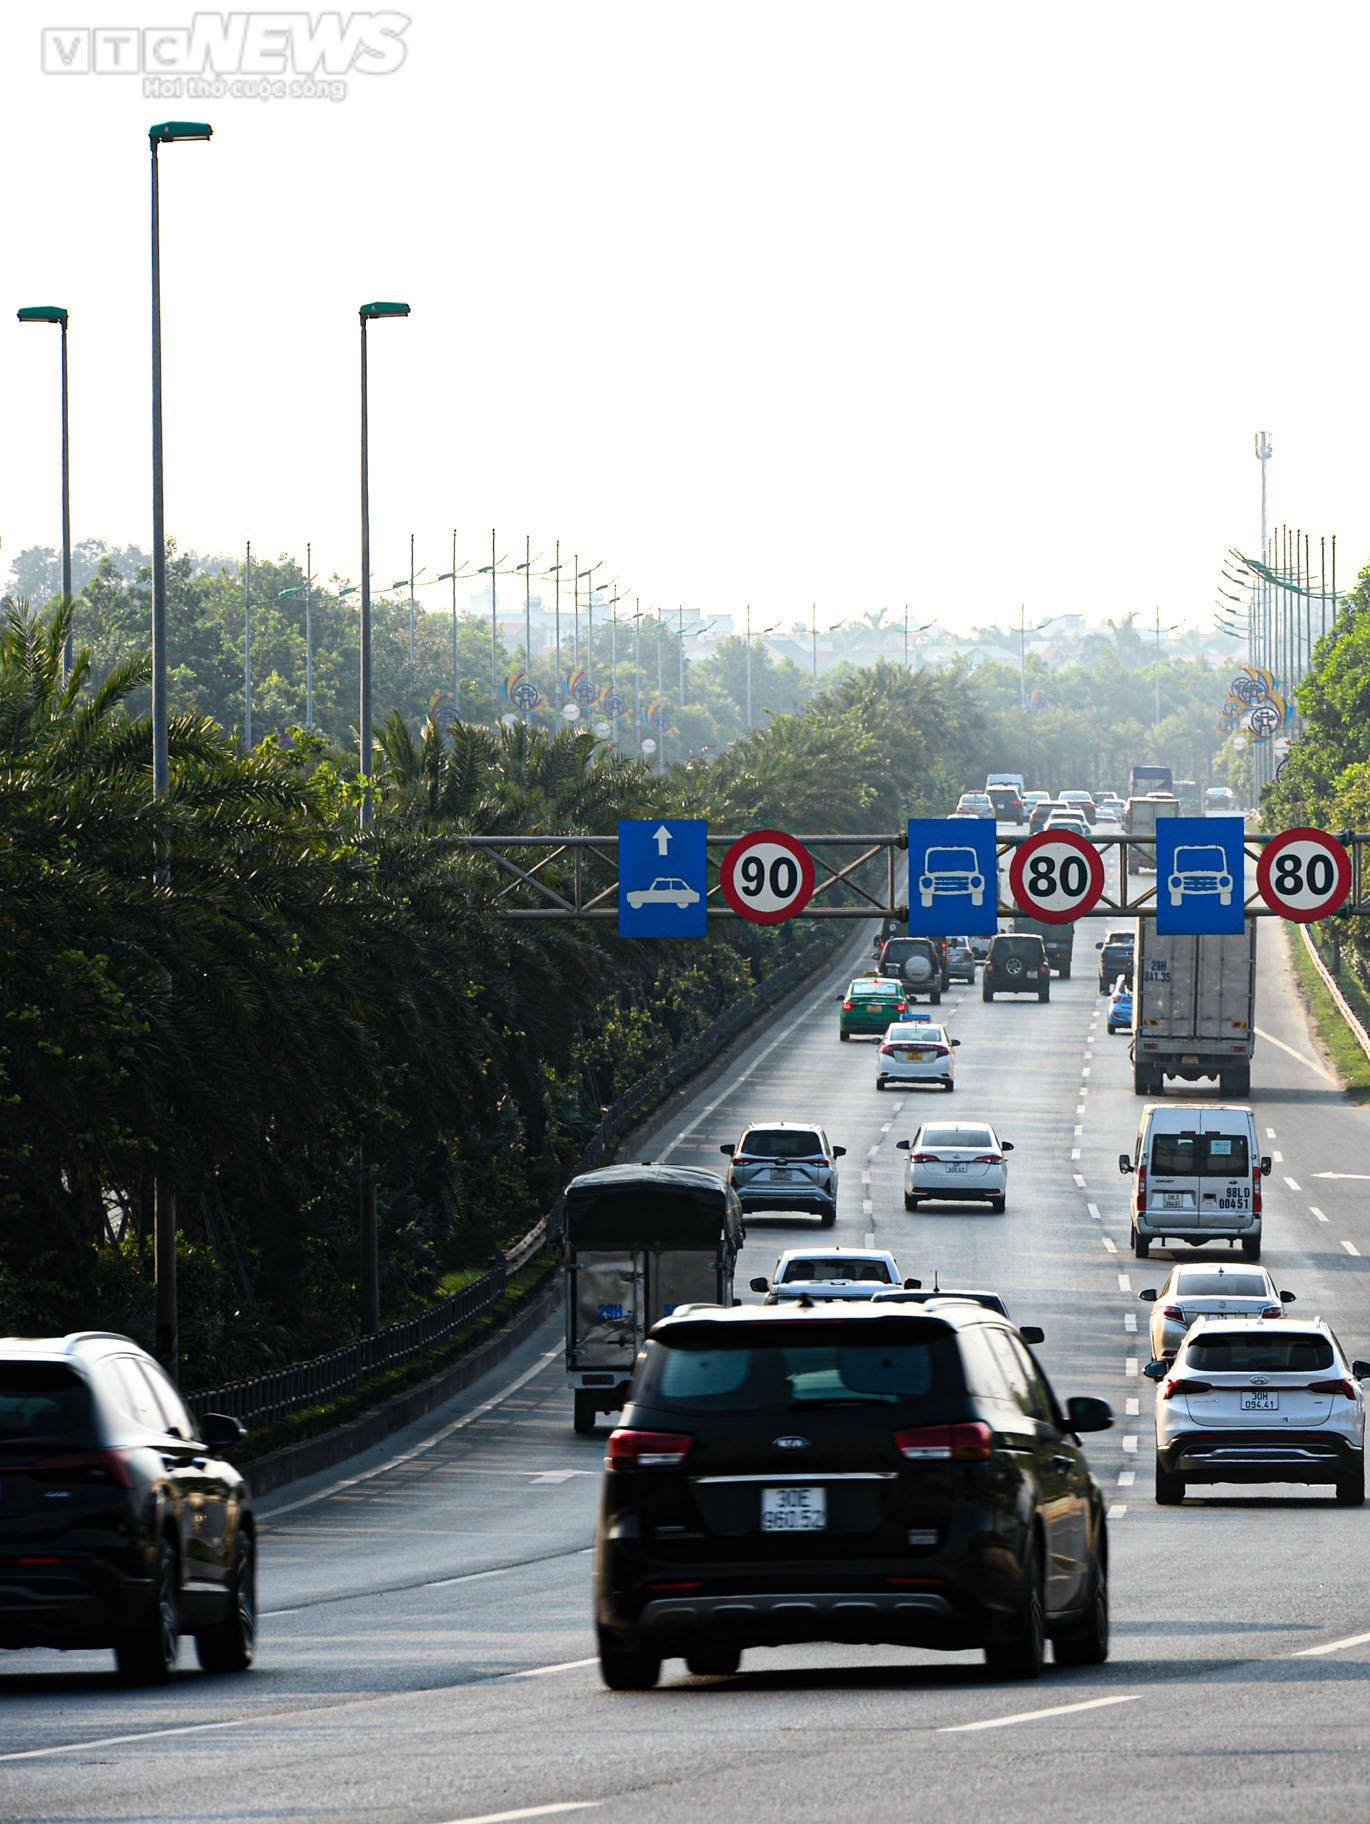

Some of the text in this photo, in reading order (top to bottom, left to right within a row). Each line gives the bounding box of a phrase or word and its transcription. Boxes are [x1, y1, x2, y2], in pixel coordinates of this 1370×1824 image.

[741, 856, 798, 899] 90
[1028, 856, 1088, 898] 80
[1275, 854, 1334, 896] 80
[1226, 1187, 1250, 1198] 98LD
[1219, 1198, 1249, 1209] 00451
[1251, 1391, 1268, 1400] 30H
[1245, 1401, 1274, 1409] 094.41
[776, 1488, 811, 1508] 30E
